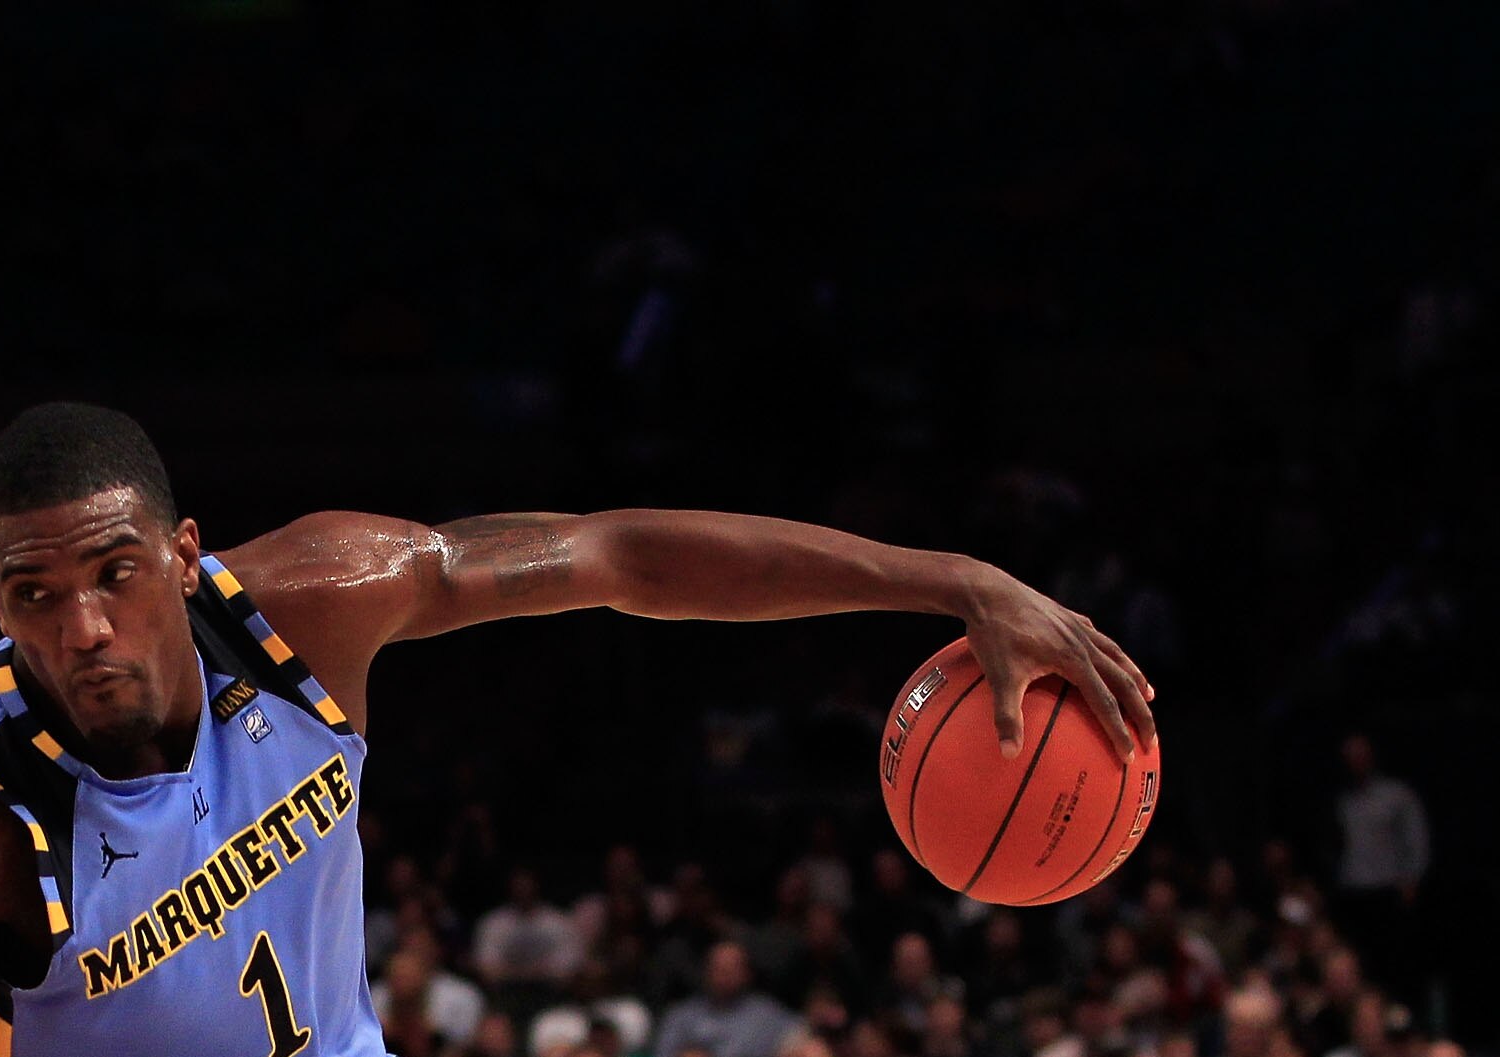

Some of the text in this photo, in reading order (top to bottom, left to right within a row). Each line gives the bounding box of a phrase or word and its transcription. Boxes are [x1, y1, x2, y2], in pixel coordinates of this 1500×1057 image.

[216, 679, 256, 717] HANK
[882, 666, 946, 787] ELITE
[78, 752, 356, 1000] MARQUETTE
